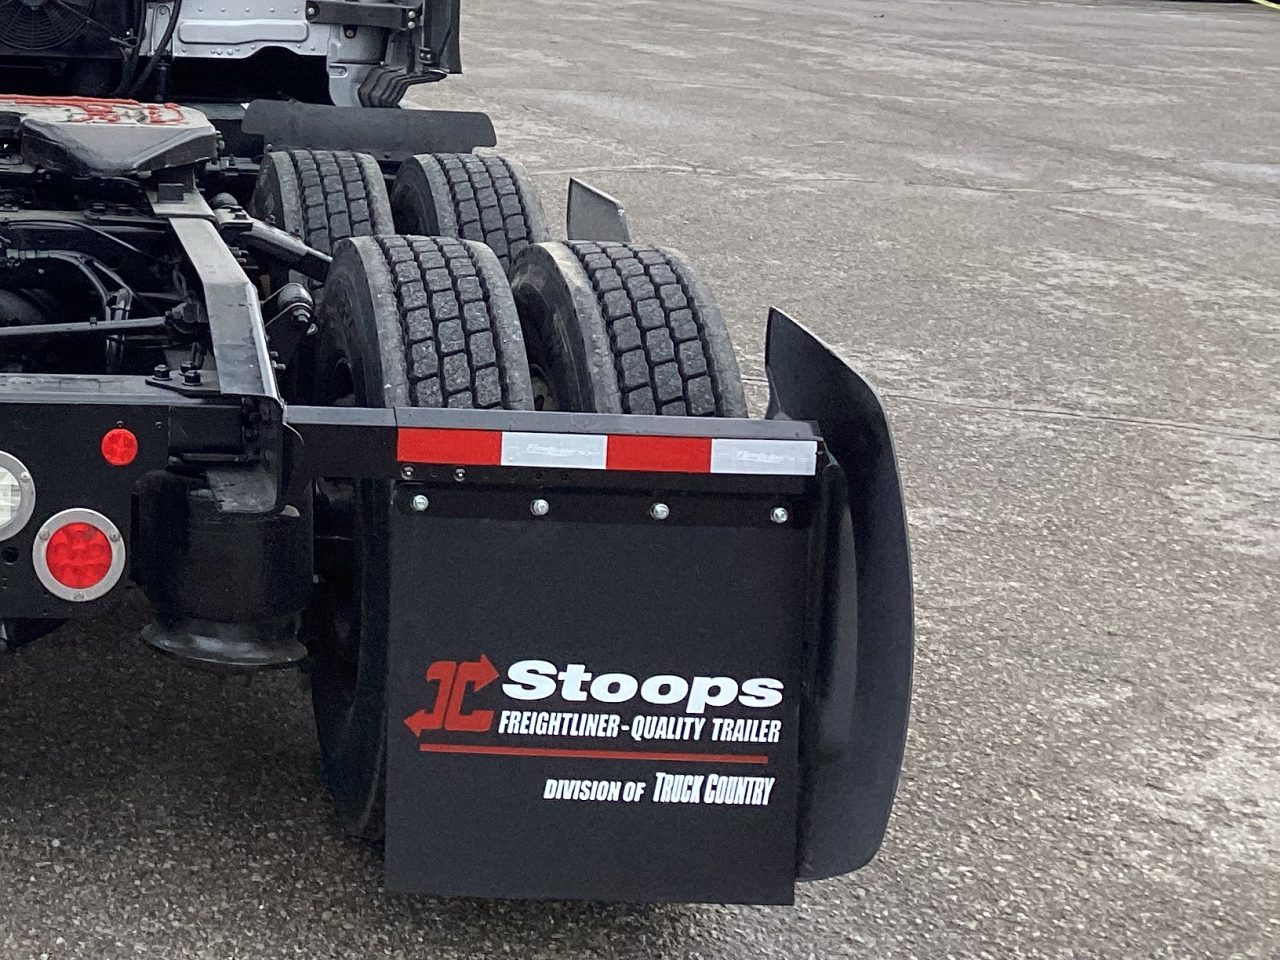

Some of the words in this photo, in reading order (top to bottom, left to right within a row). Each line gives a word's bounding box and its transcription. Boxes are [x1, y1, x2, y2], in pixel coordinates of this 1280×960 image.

[501, 658, 785, 714] Stoops
[711, 717, 782, 743] TRAILER
[542, 778, 621, 802] DIVISION
[622, 781, 647, 803] OF
[652, 771, 704, 804] TRUCK
[703, 773, 776, 806] COUNTRY
